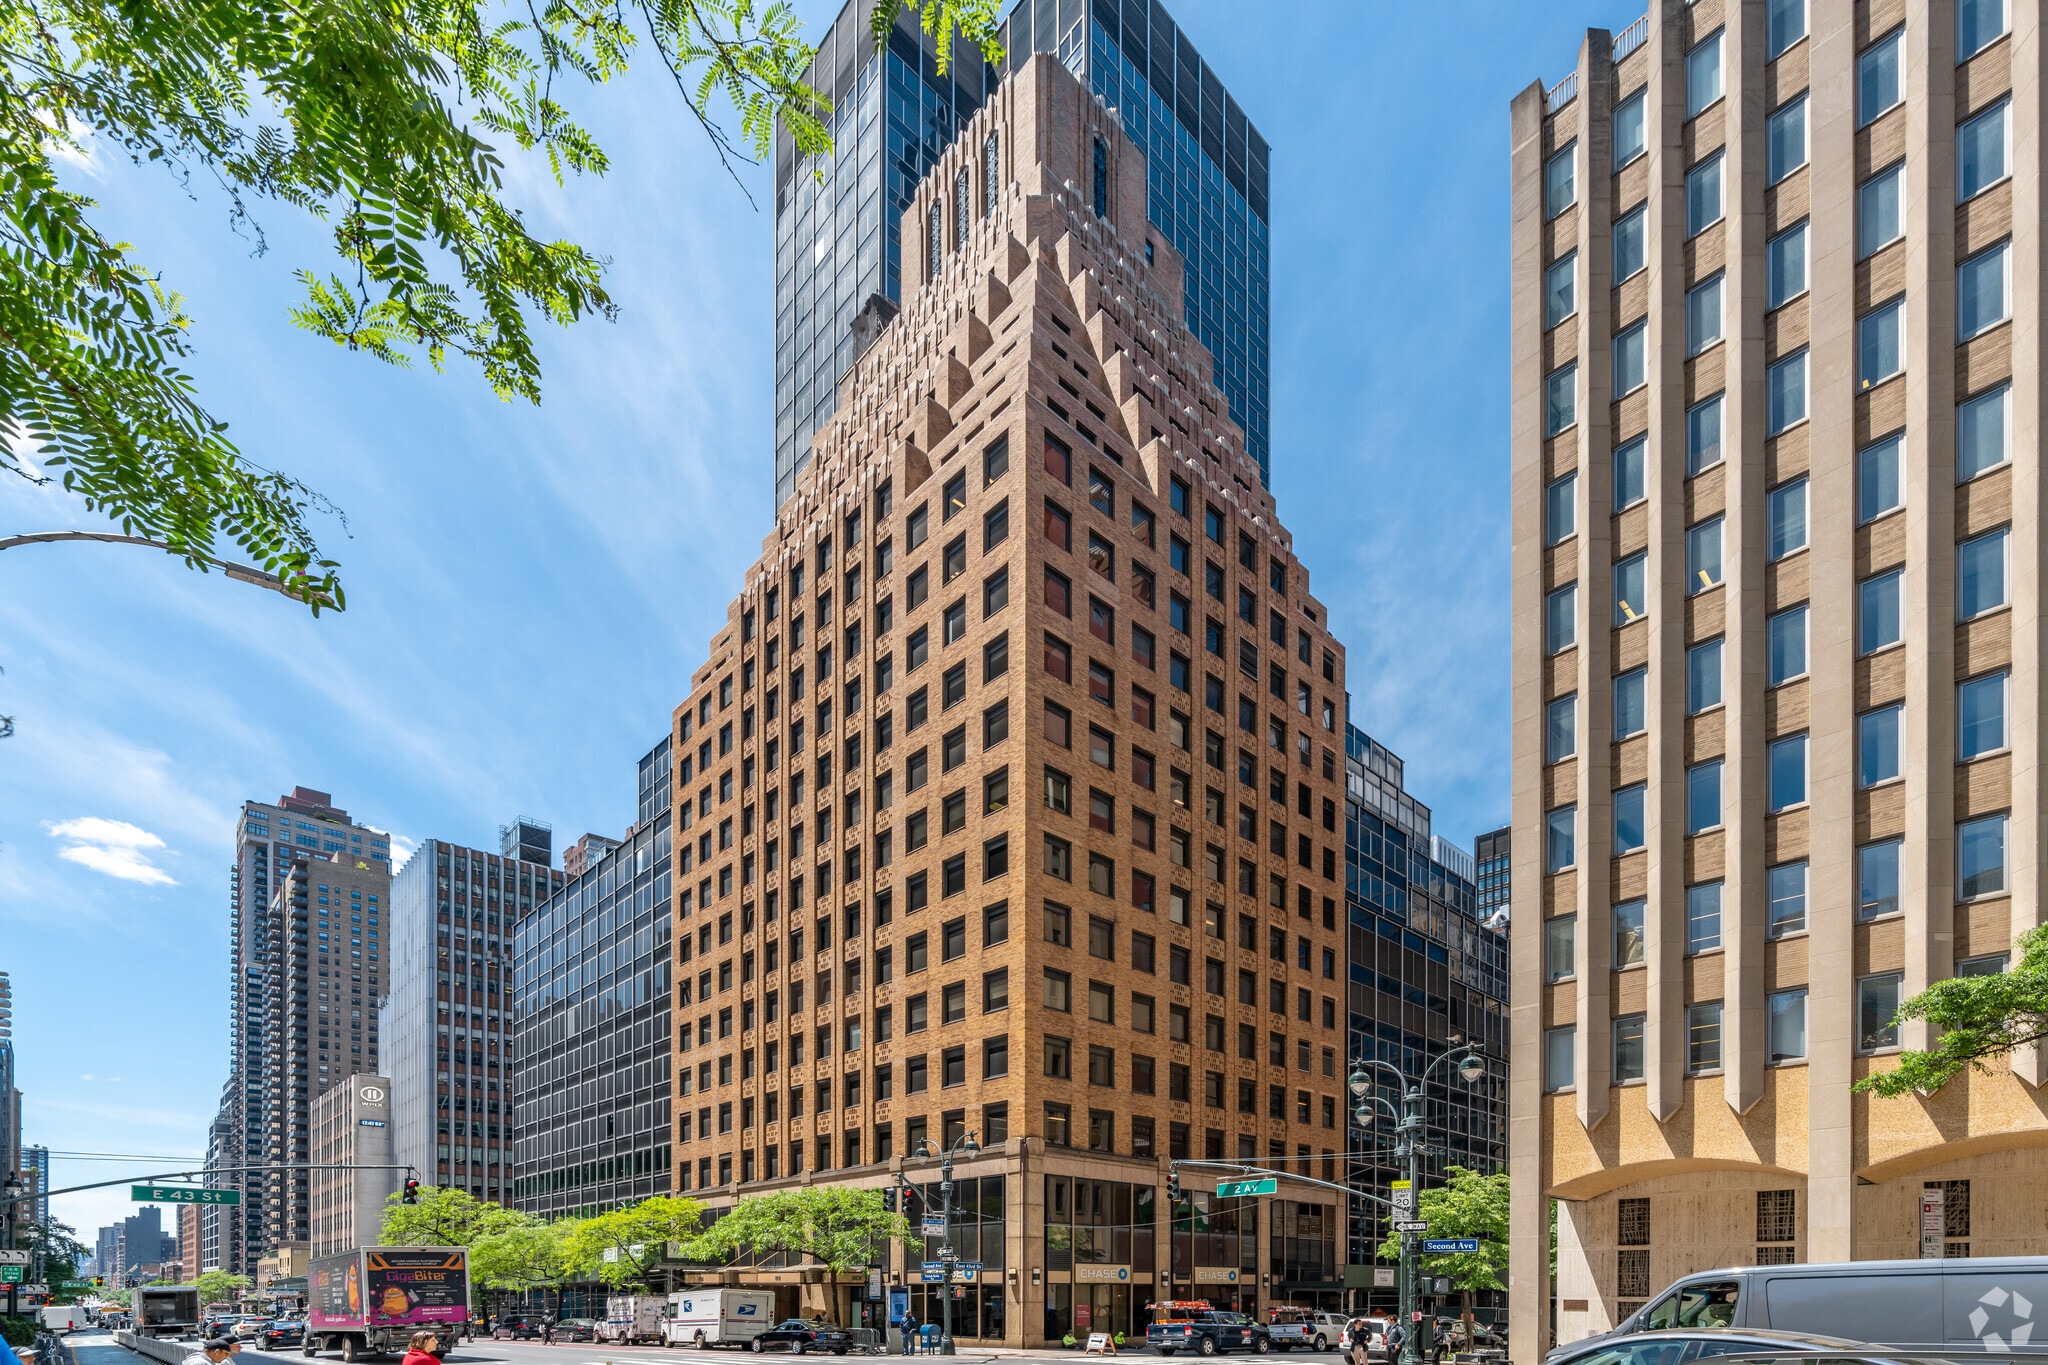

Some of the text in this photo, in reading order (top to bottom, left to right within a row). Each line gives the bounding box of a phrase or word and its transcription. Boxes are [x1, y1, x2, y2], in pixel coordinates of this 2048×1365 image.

[1234, 1184, 1258, 1193] 2 Av
[153, 1189, 221, 1202] E 43 St
[1395, 1198, 1409, 1206] 20
[386, 1270, 447, 1282] GigaBiter
[1080, 1268, 1117, 1279] CHASE
[1198, 1271, 1228, 1280] CHASE
